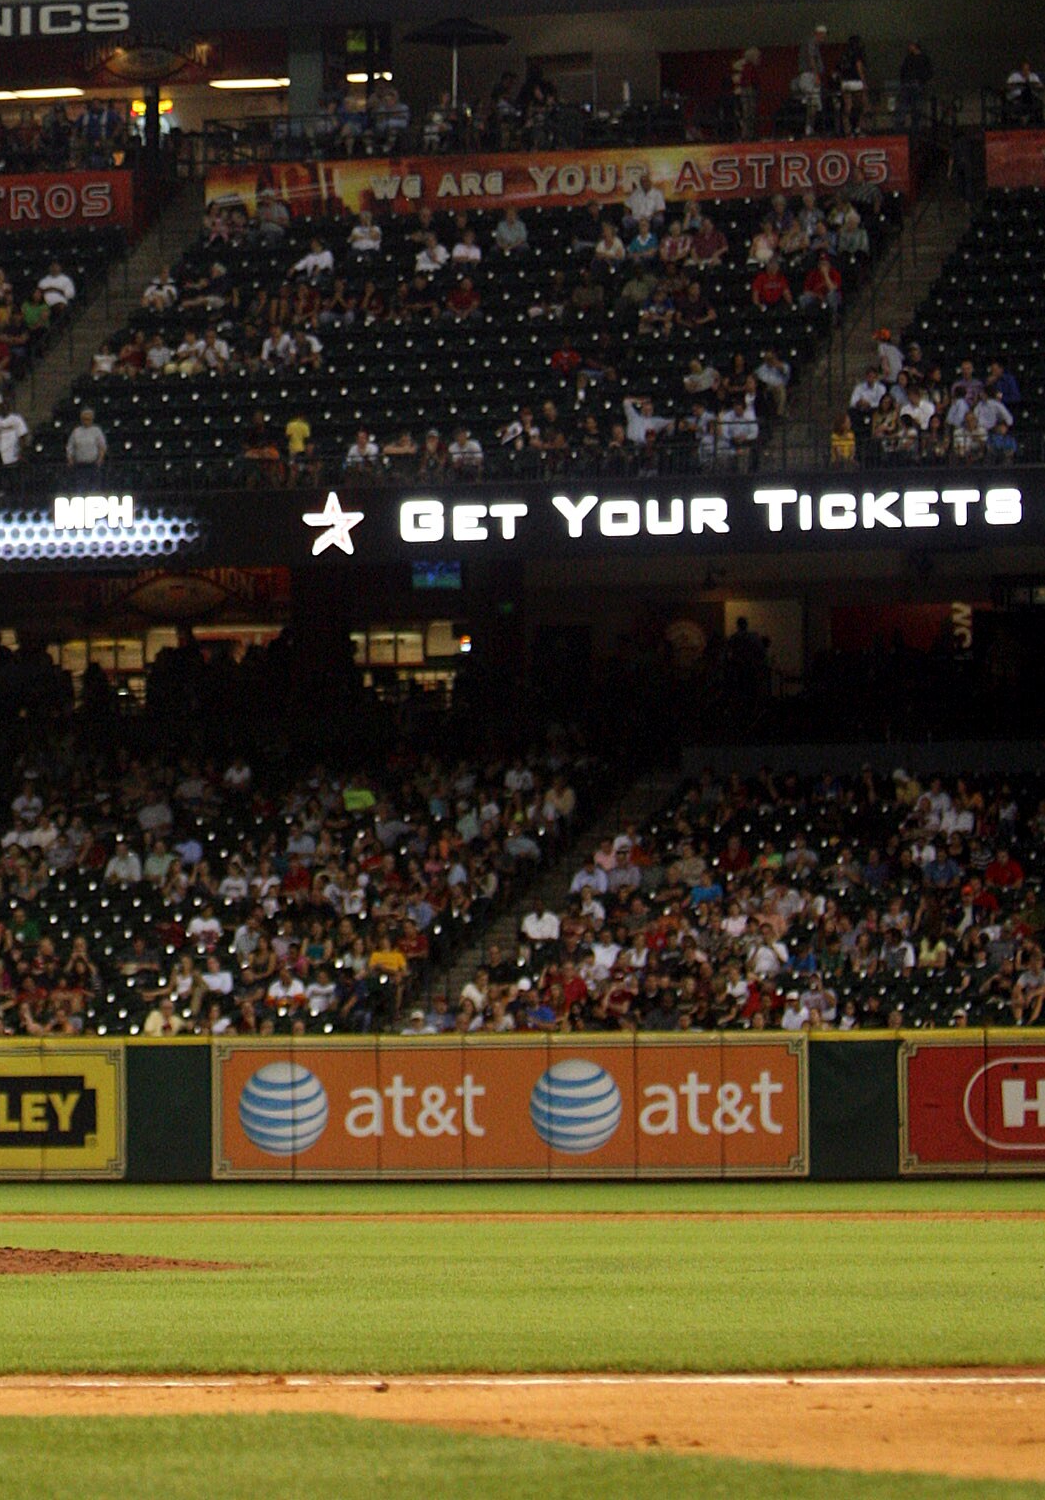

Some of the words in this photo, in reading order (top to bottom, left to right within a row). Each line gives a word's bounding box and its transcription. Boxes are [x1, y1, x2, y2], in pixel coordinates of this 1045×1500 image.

[437, 169, 503, 198] ARE
[529, 164, 648, 194] YOUR
[675, 150, 888, 193] ASTROS
[56, 496, 133, 528] MPH
[344, 1074, 486, 1138] at&t
[640, 1071, 783, 1135] at&t
